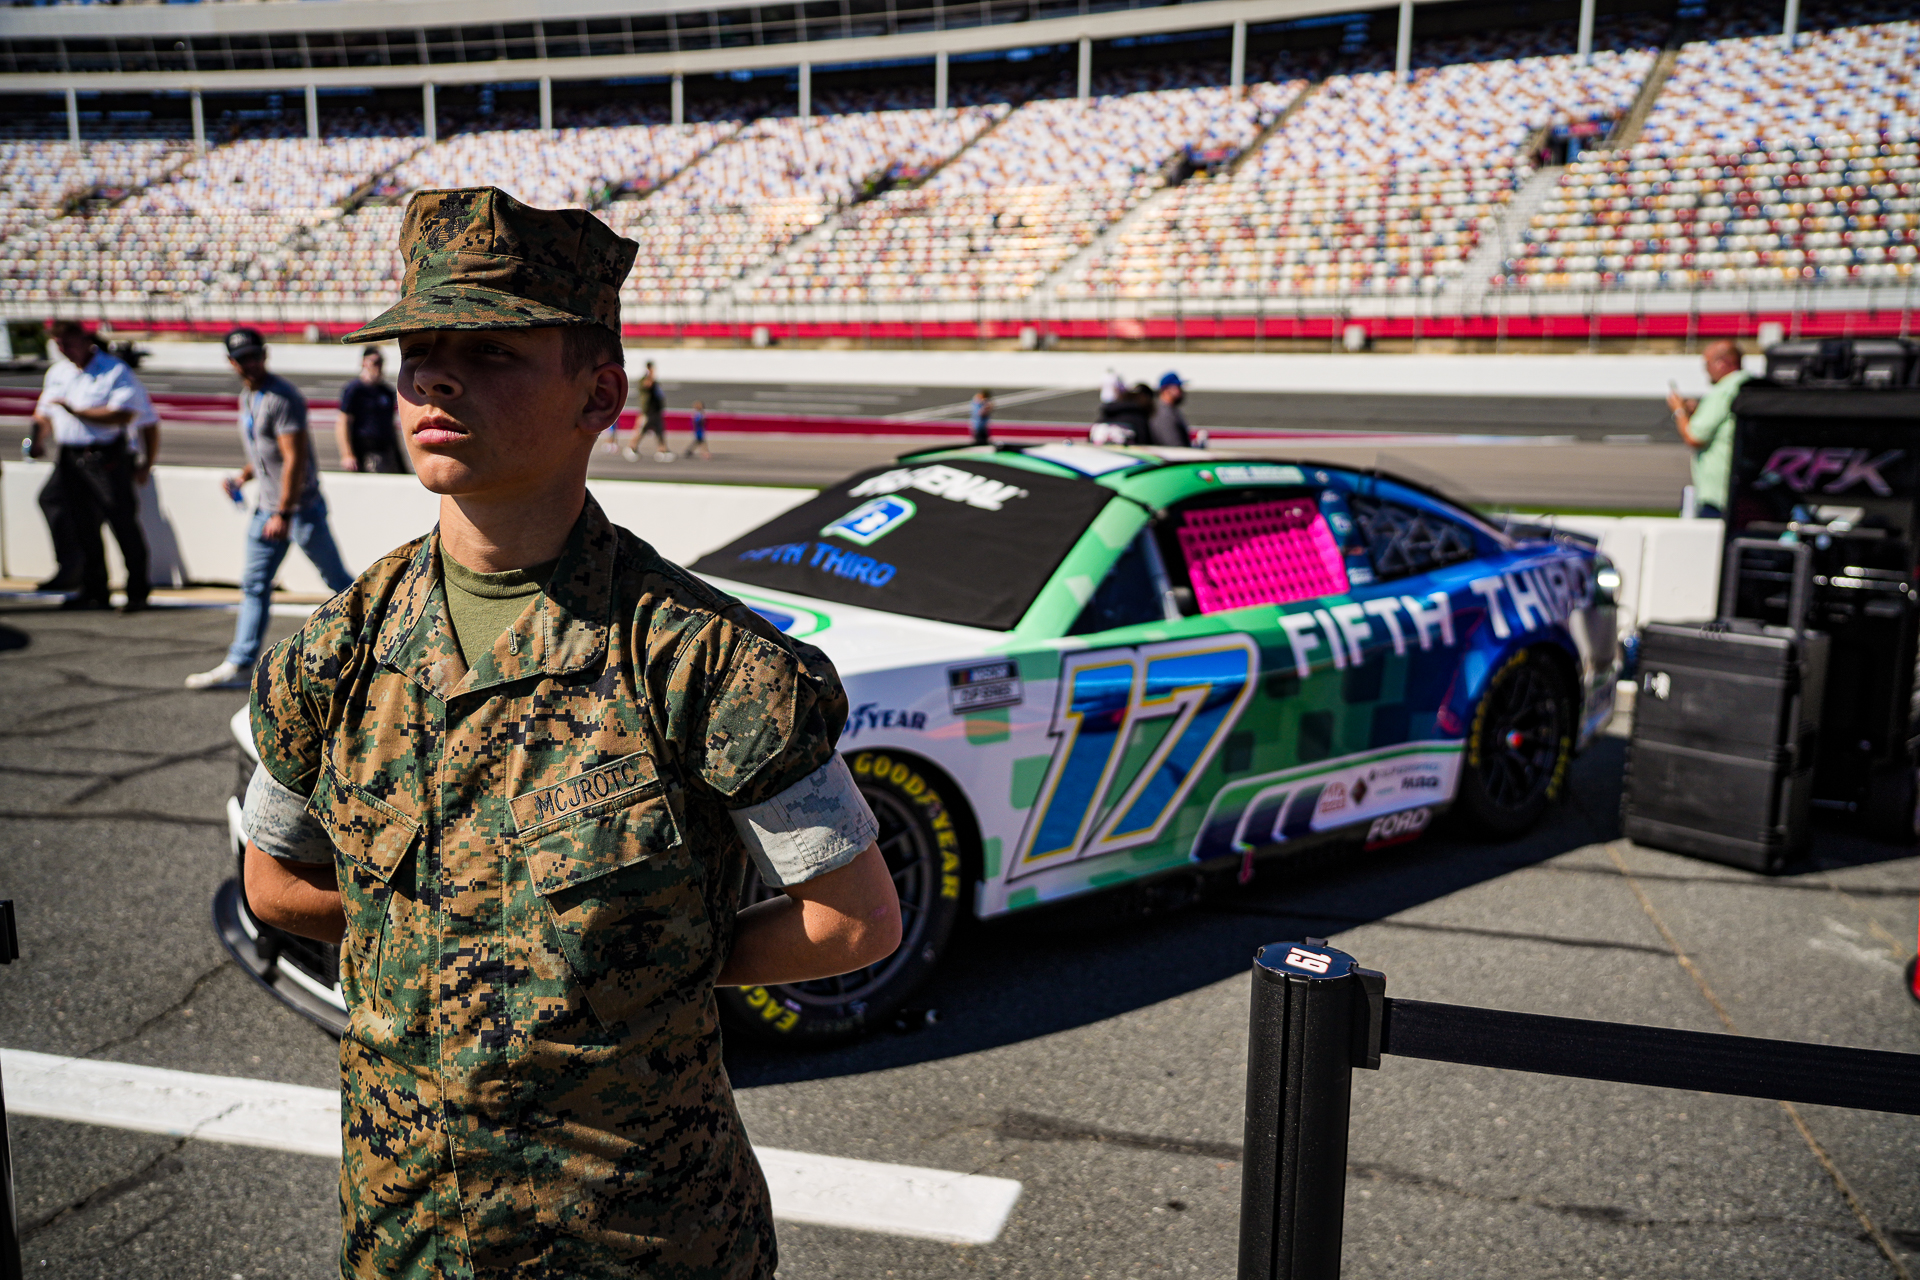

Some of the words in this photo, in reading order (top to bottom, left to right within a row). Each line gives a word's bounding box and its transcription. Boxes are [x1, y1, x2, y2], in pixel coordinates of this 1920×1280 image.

[1753, 446, 1904, 497] RFK
[1278, 591, 1455, 679] FIFTH
[1469, 560, 1597, 640] THIRD
[1004, 632, 1259, 885] 17
[533, 761, 637, 820] MCJROTC
[1366, 807, 1431, 843] FORD
[740, 985, 800, 1032] EAG
